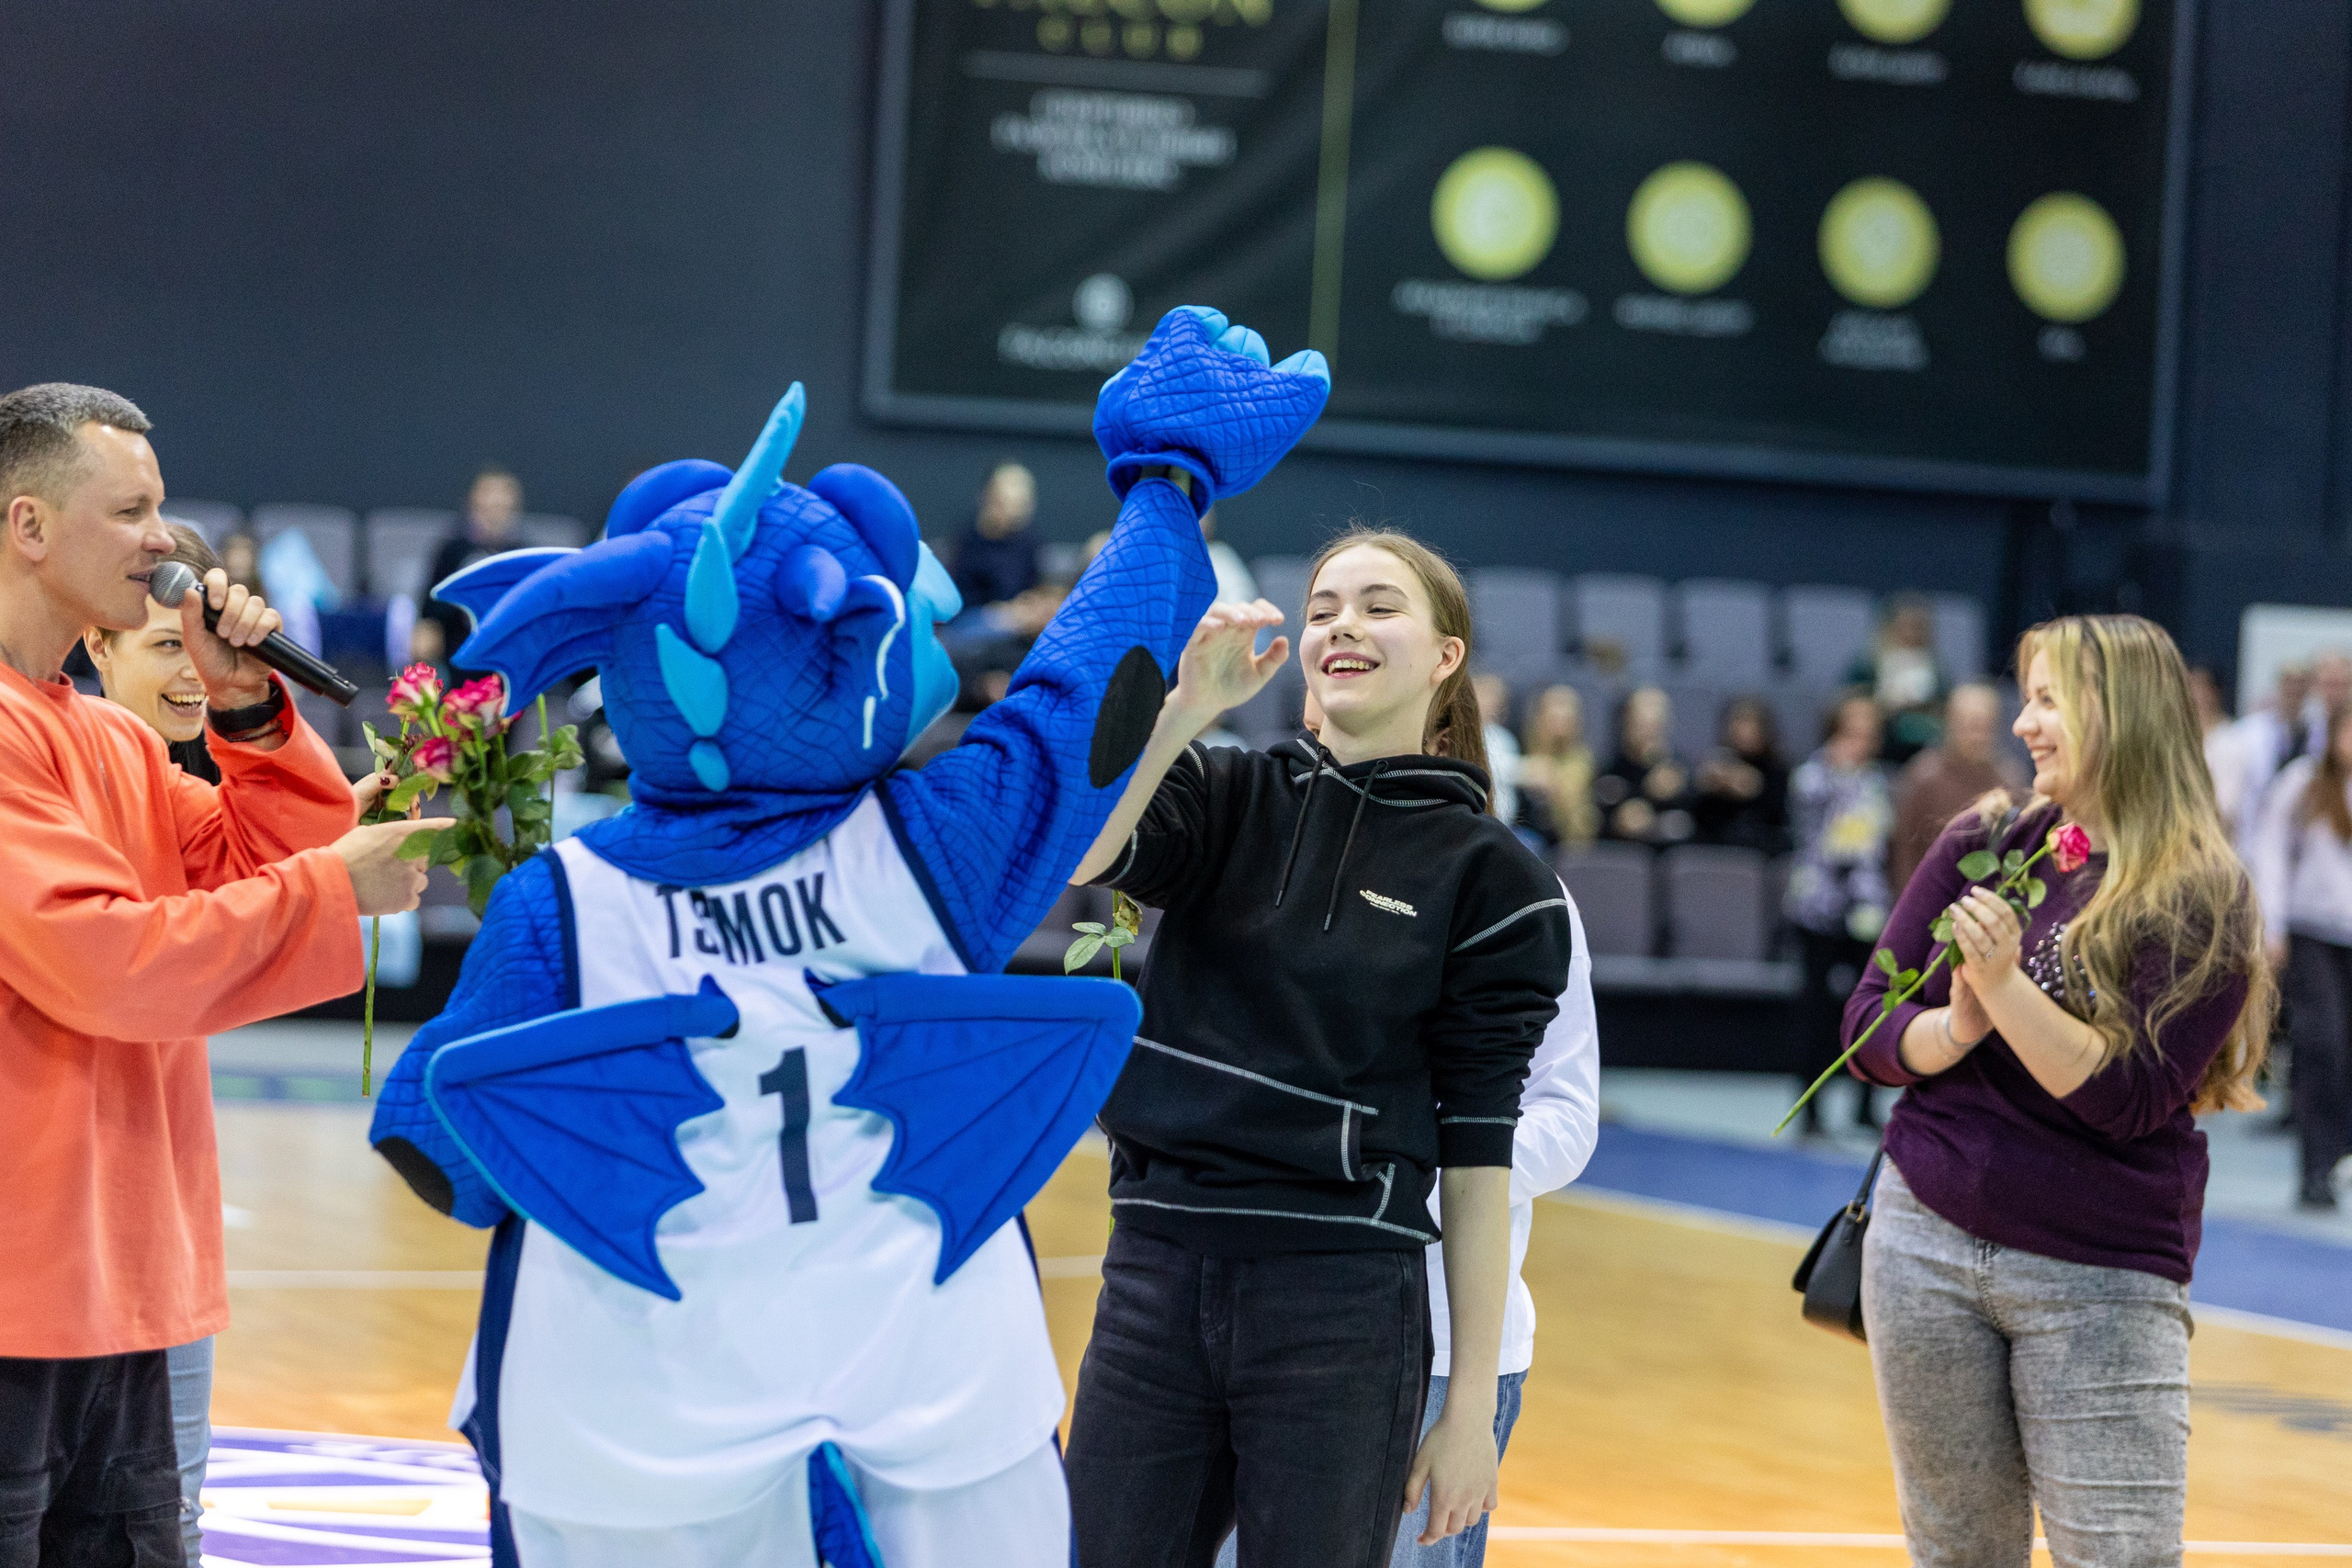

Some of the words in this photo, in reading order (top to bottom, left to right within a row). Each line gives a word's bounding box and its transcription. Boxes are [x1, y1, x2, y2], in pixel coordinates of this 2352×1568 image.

[1360, 889, 1418, 917] CONNECTION
[1366, 889, 1413, 910] FEARLESS
[758, 1045, 819, 1224] 1
